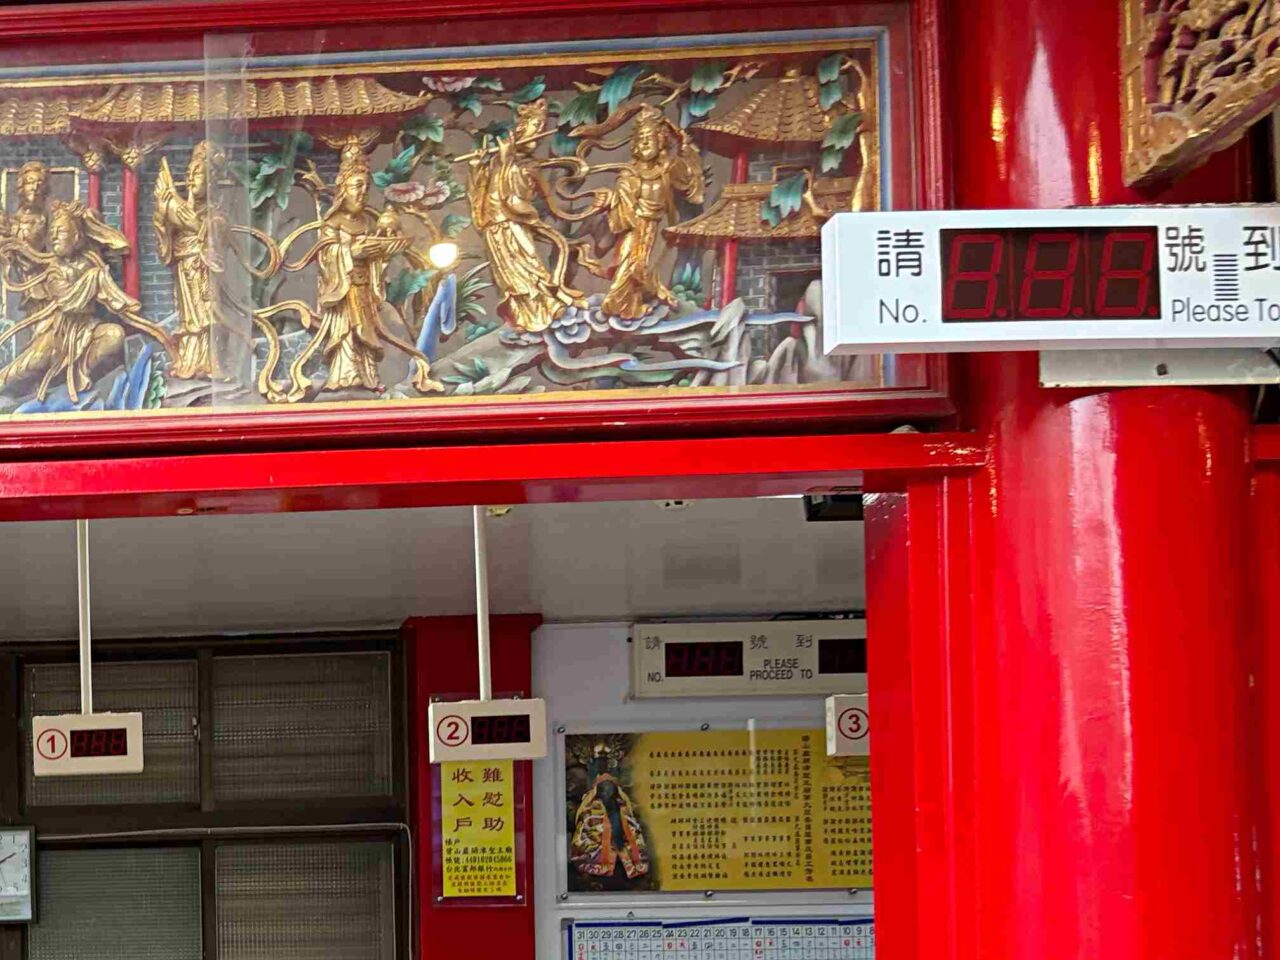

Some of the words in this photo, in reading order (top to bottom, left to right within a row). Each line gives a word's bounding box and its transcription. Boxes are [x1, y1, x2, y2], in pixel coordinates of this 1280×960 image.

[876, 228, 924, 278] 請
[1164, 225, 1207, 273] 號
[878, 298, 927, 324] No.
[1171, 298, 1249, 323] Please
[750, 634, 768, 650] 號
[795, 634, 813, 649] 到
[763, 658, 799, 670] PLEASE
[647, 671, 664, 683] NO.
[749, 669, 793, 681] PROCEED
[800, 668, 813, 680] TO
